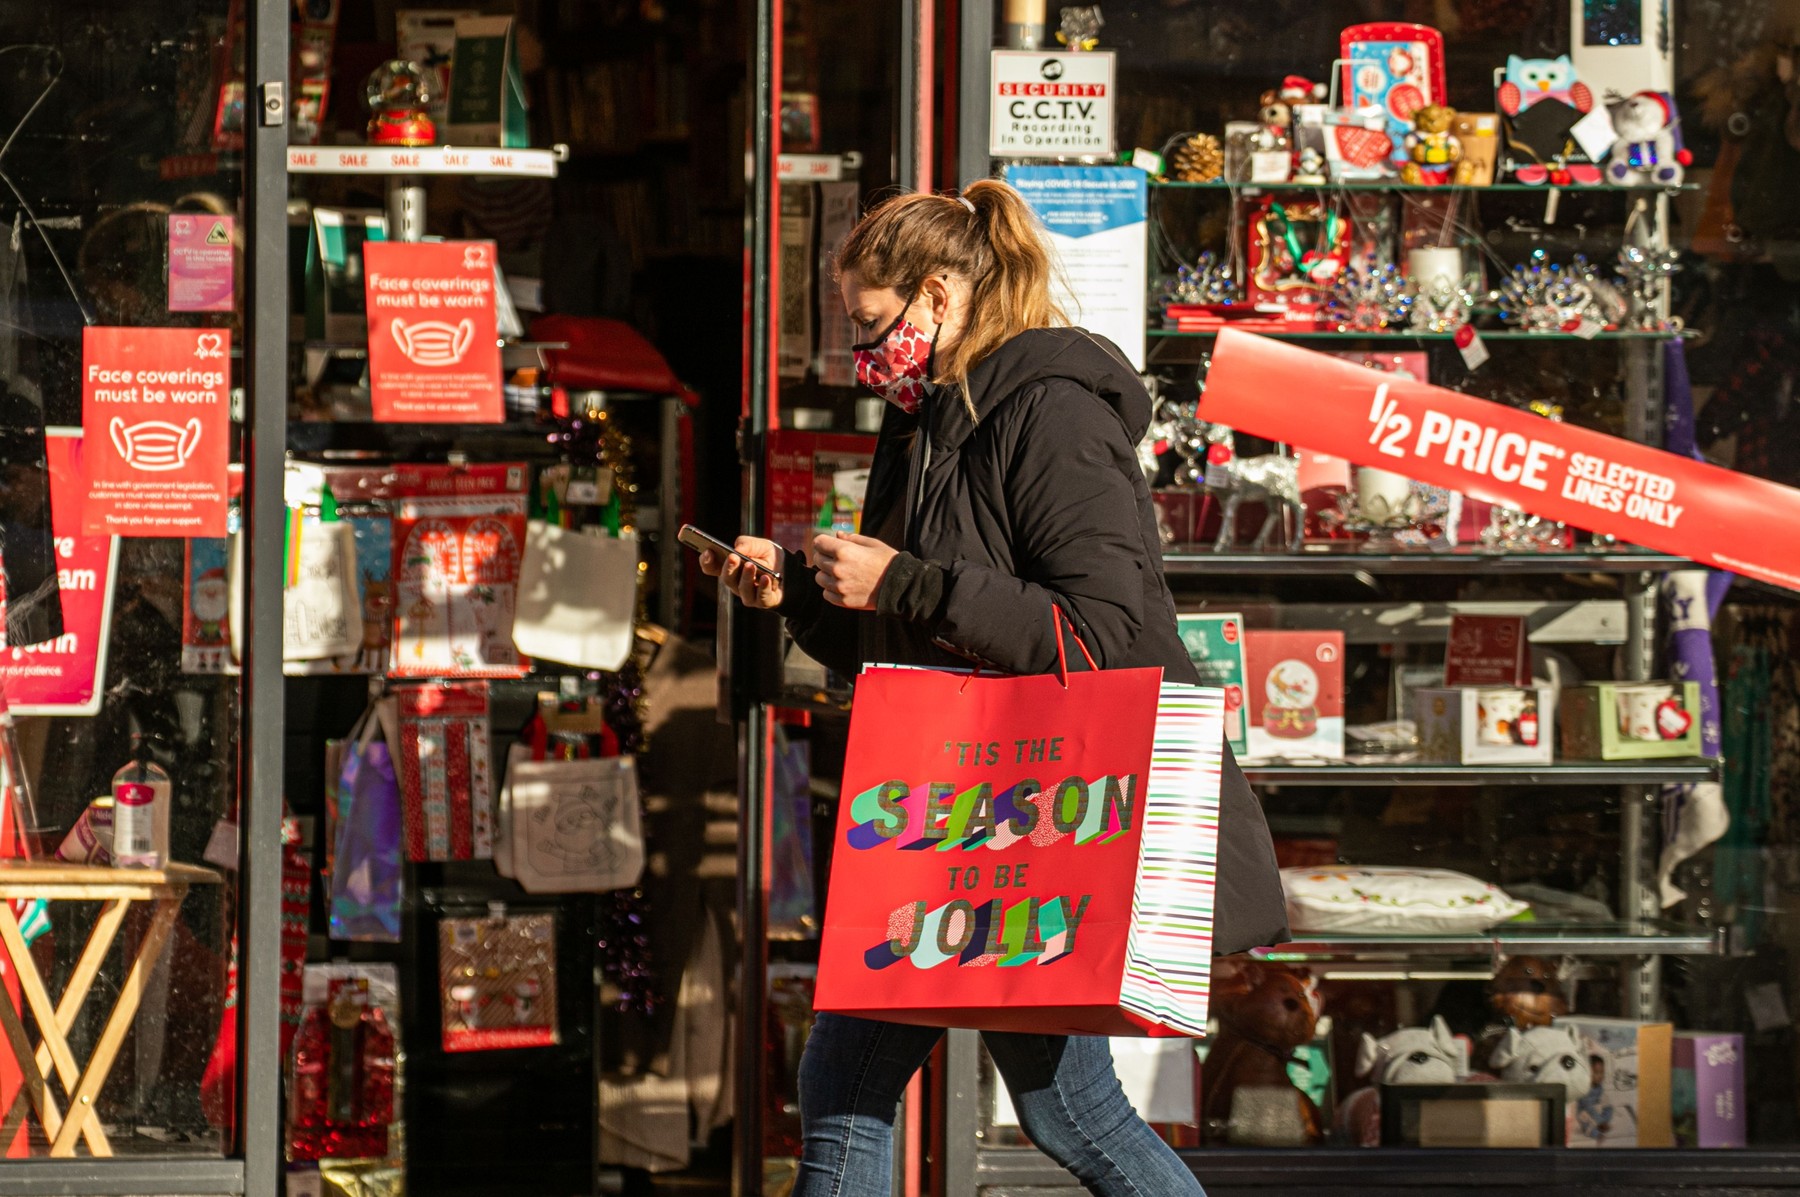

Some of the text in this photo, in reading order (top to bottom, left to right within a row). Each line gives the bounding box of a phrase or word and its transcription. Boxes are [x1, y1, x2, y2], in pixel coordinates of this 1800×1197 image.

[1002, 84, 1104, 96] SECURITY
[1009, 101, 1095, 120] C.C.T.V.
[1012, 122, 1091, 134] Recording
[1002, 134, 1101, 146] In Operation
[290, 154, 317, 166] SALE
[339, 154, 367, 167] SALE
[391, 154, 419, 167] SALE
[442, 154, 468, 166] SALE
[489, 154, 513, 168] SALE
[369, 273, 490, 293] Face coverings
[376, 293, 484, 308] must be worn
[88, 365, 223, 389] Face coverings
[94, 386, 217, 404] must be worn
[93, 480, 101, 489] In
[102, 480, 114, 489] line
[115, 480, 131, 489] with
[132, 481, 175, 491] government
[1567, 452, 1676, 501] SELECTED
[88, 491, 125, 499] customers
[126, 491, 144, 499] must
[171, 491, 187, 499] face
[1562, 476, 1683, 528] LINES ONLY
[105, 514, 128, 524] Thank
[129, 517, 142, 526] you
[143, 515, 154, 524] for
[155, 517, 171, 526] your
[944, 737, 1064, 767] 'TIS THE
[866, 774, 1138, 842] SEASON
[947, 863, 1029, 890] TO BE
[884, 894, 1092, 960] JOLLY
